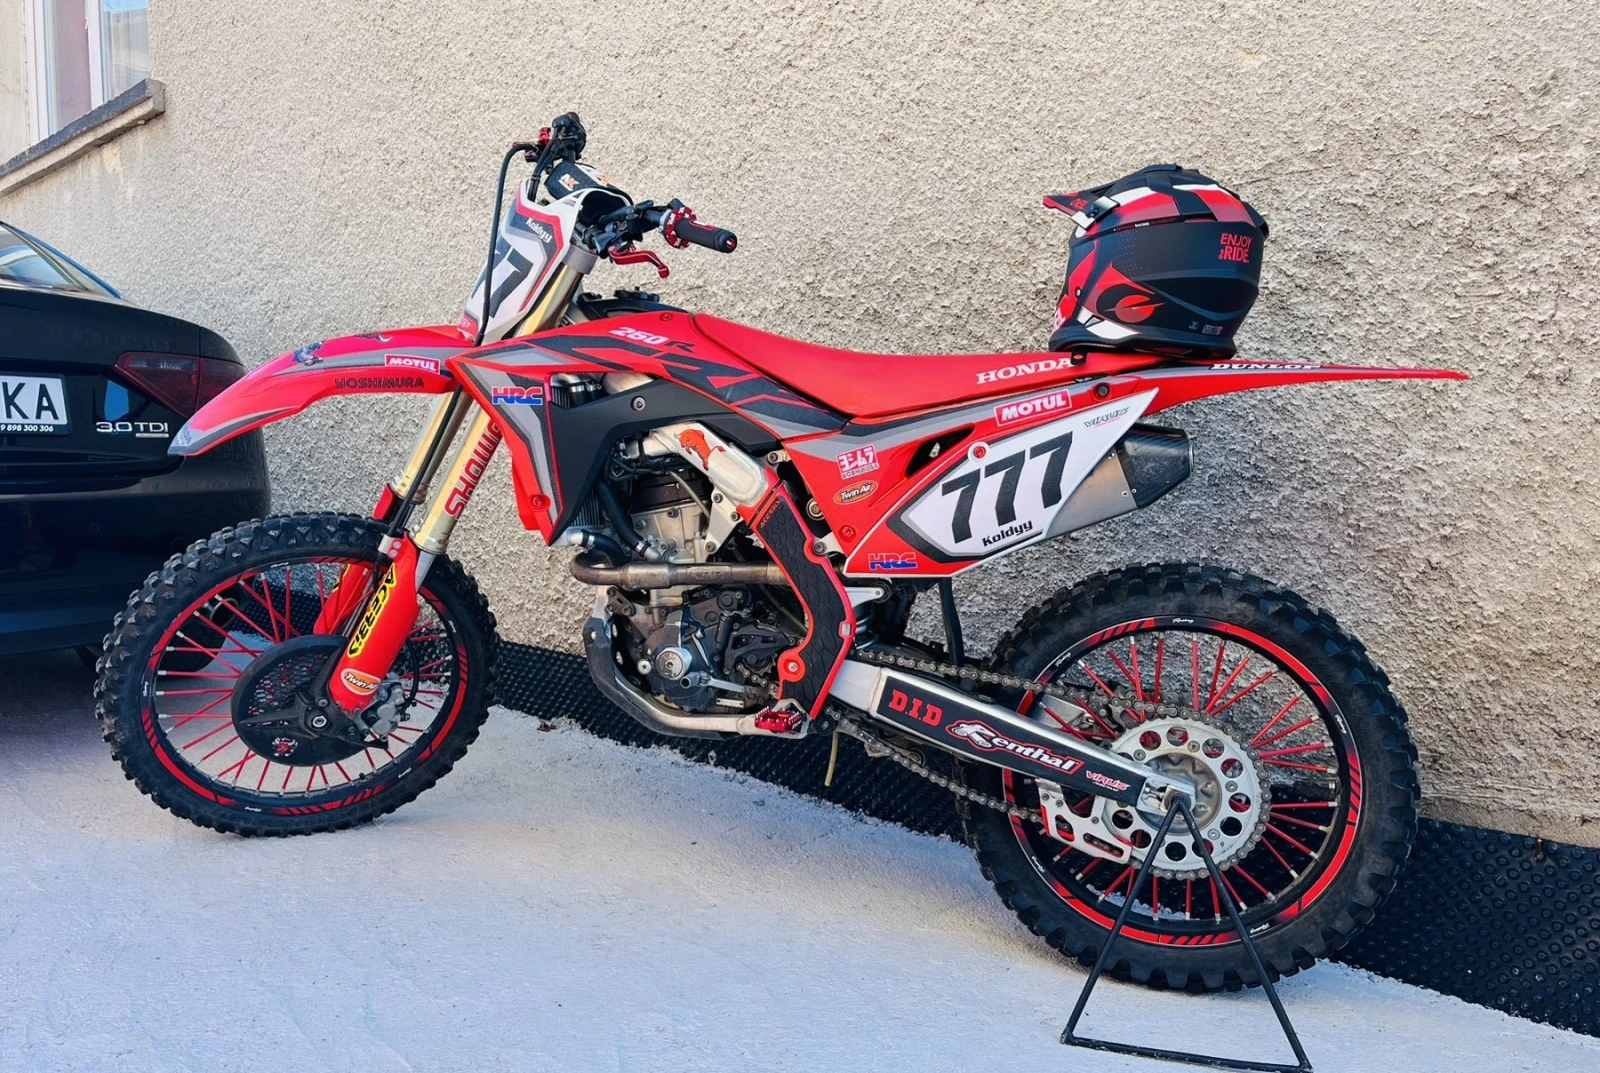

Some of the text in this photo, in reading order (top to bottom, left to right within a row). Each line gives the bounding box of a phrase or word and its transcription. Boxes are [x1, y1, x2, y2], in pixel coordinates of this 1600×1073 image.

[525, 216, 553, 243] Koldyy
[1220, 232, 1253, 248] ENJOY
[1223, 245, 1249, 263] RIDE
[389, 358, 436, 371] MOTUL
[976, 357, 1075, 384] HONDA
[334, 376, 425, 389] YOSHIMURA
[2, 381, 59, 420] KA
[492, 386, 543, 405] HRC
[1002, 394, 1066, 421] MOTUL
[95, 421, 169, 433] 3.0 TDI
[840, 482, 872, 501] Twin Air
[942, 430, 1073, 544] 777
[982, 520, 1033, 547] Koldyy
[868, 552, 918, 571] HRC
[349, 562, 396, 656] ACERBIS
[345, 671, 367, 689] Twin
[888, 689, 943, 727] D.I.D
[951, 723, 1079, 770] Renthal
[1086, 770, 1131, 790] VIRUS
